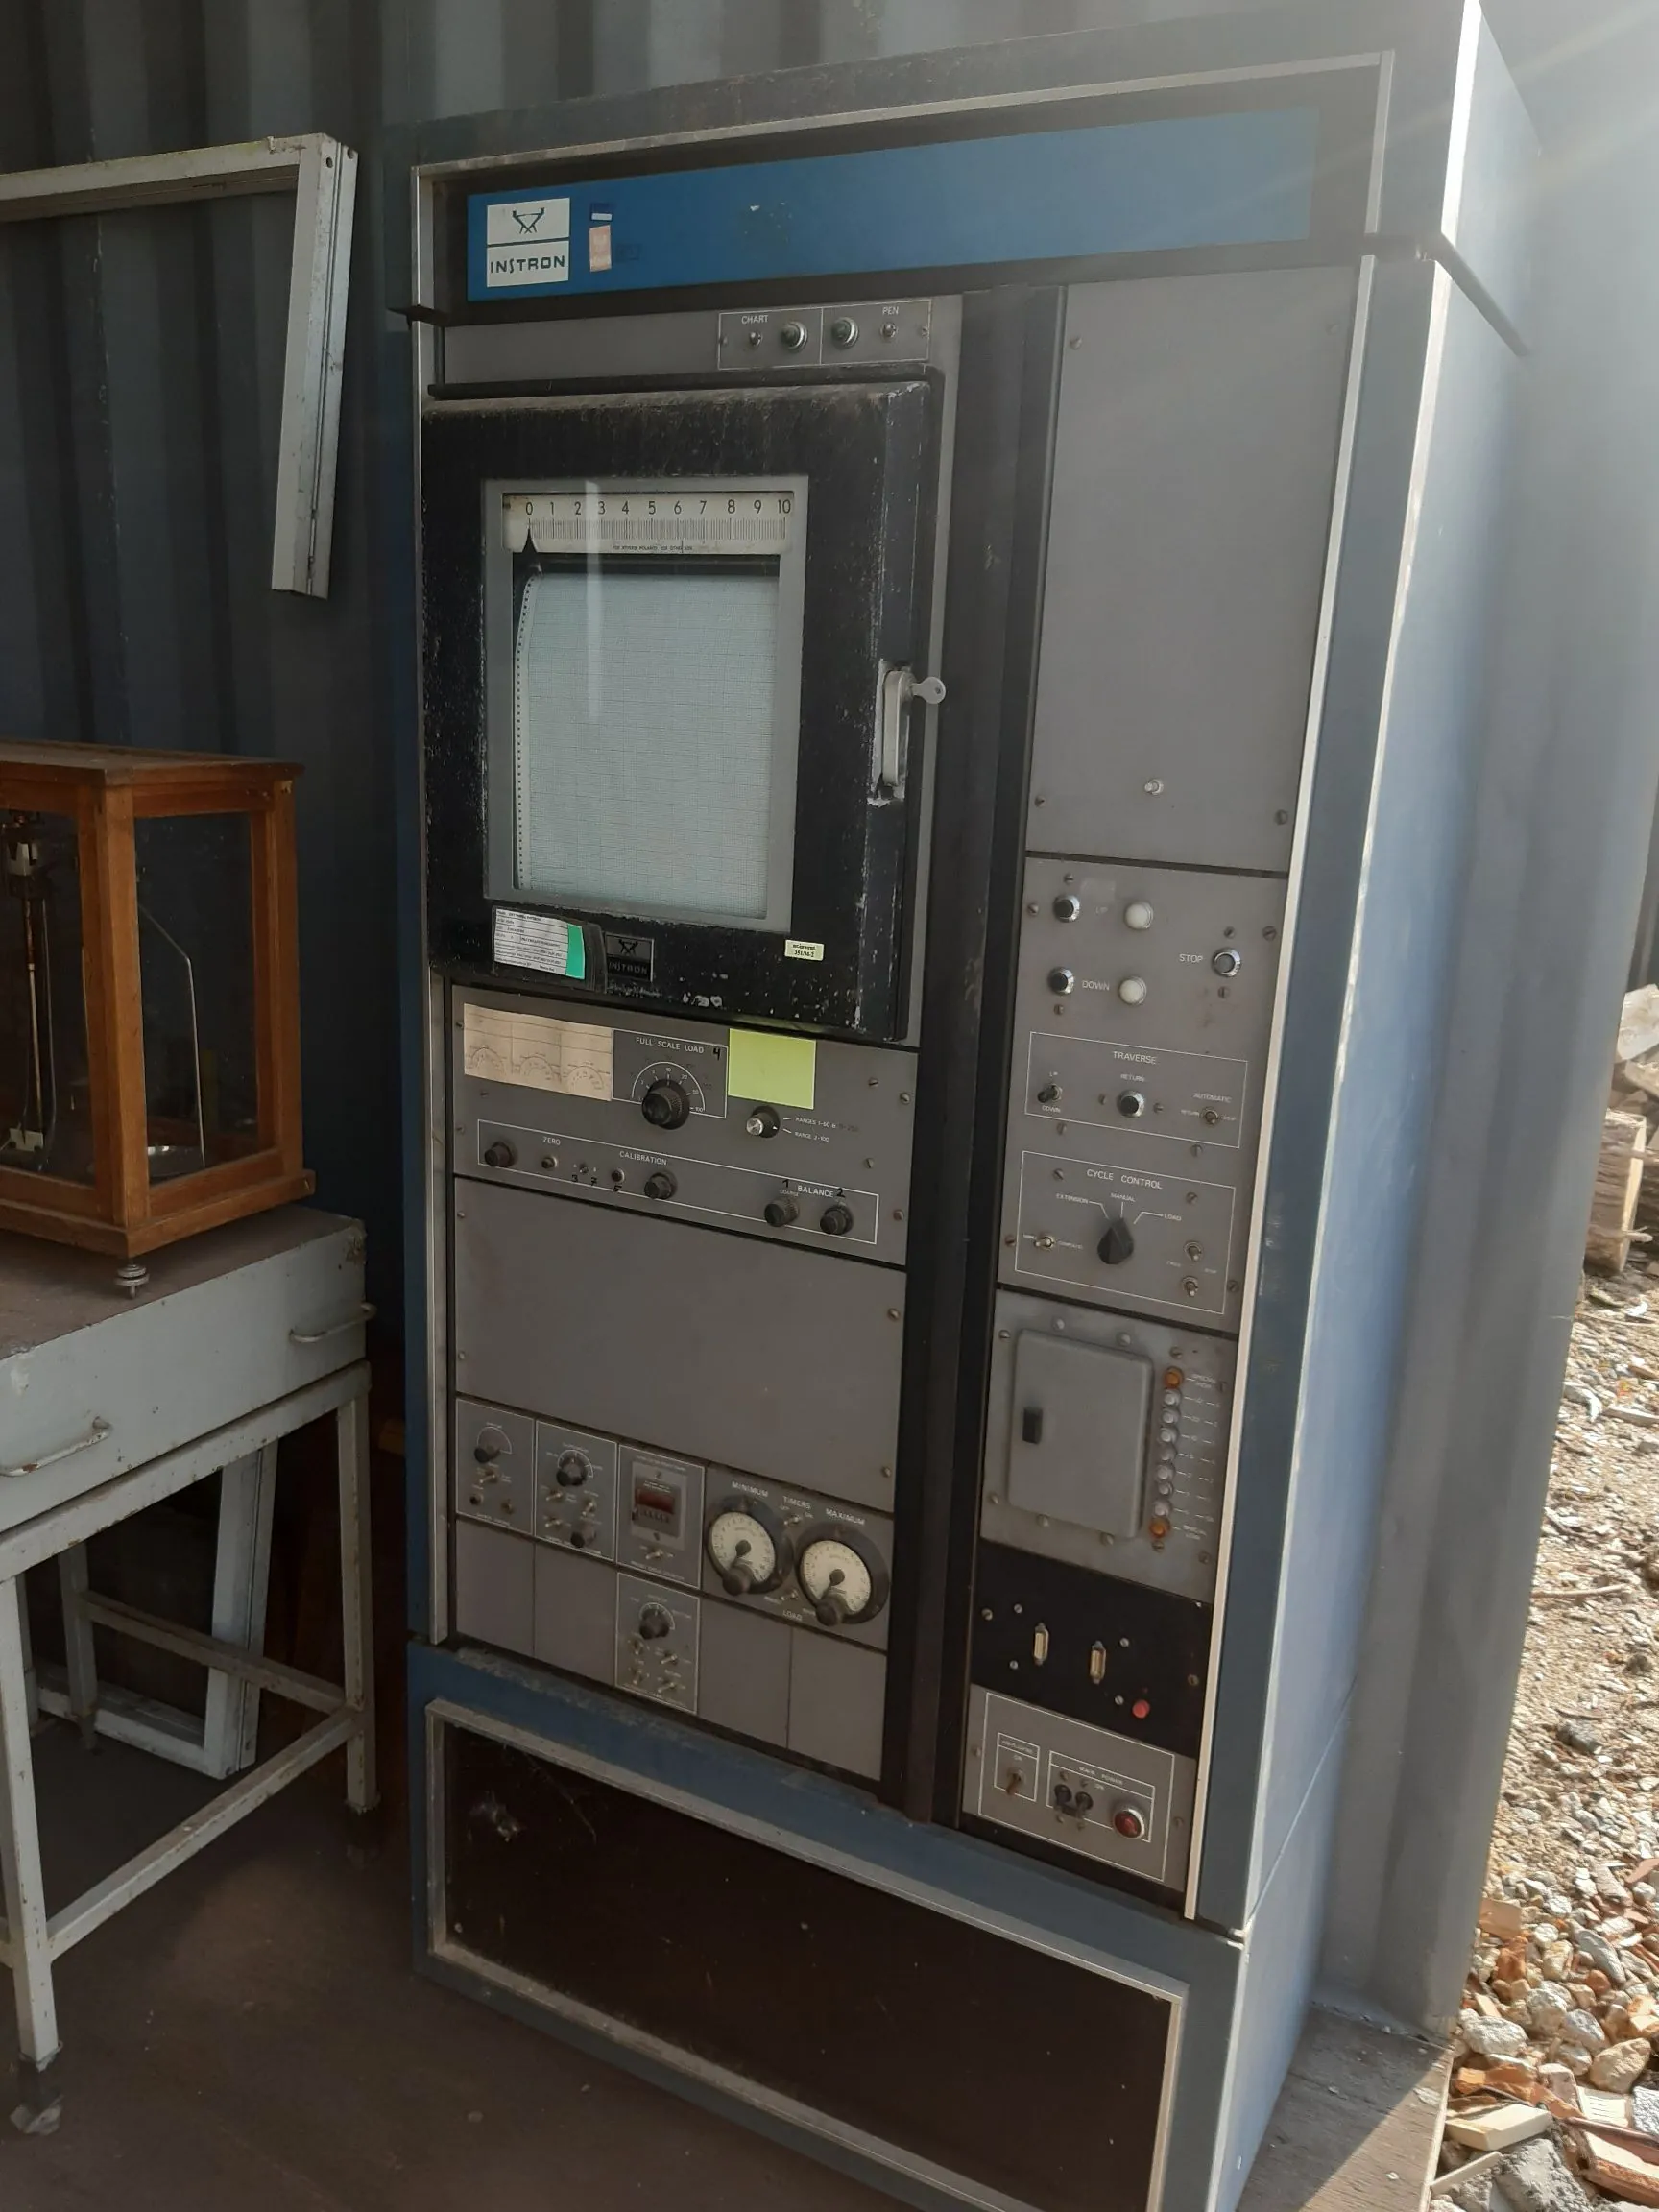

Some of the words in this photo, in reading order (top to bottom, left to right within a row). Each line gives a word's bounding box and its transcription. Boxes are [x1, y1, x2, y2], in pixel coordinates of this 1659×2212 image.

[490, 255, 565, 274] INSTRON
[882, 305, 899, 316] PEN
[741, 314, 768, 325] CHART
[525, 501, 534, 516] 0
[549, 501, 555, 515] 1
[574, 501, 582, 516] 2
[597, 500, 606, 515] 3
[621, 500, 630, 515] 4
[648, 500, 656, 515] 5
[674, 500, 682, 515] 6
[699, 500, 708, 515] 7
[727, 499, 736, 515] 8
[754, 499, 762, 515] 9
[777, 498, 791, 515] 10
[1179, 953, 1204, 963] STOP
[609, 961, 648, 974] INSTRON
[1082, 979, 1110, 991] DOWN
[636, 1036, 653, 1046] FULL
[657, 1040, 681, 1050] SCALE
[684, 1044, 705, 1054] LOAD
[712, 1047, 720, 1061] 4
[1113, 1051, 1157, 1065] TRAVERSE
[1120, 1073, 1145, 1083] RETURN
[1193, 1092, 1232, 1103] AUTOMATIC
[542, 1136, 561, 1146] ZERO
[619, 1150, 667, 1166] CALIBRATION
[1087, 1168, 1114, 1181] CYCLE
[1120, 1174, 1163, 1190] CONTROL
[798, 1185, 834, 1198] BALANCE
[836, 1187, 845, 1198] 2
[1110, 1192, 1136, 1202] MANUAL
[1056, 1193, 1089, 1204] EXTENSION
[1164, 1213, 1182, 1222] LOAD
[732, 1480, 769, 1498] MINIMUM
[782, 1495, 811, 1510] TIMERS
[826, 1507, 866, 1525] MAXIMUM
